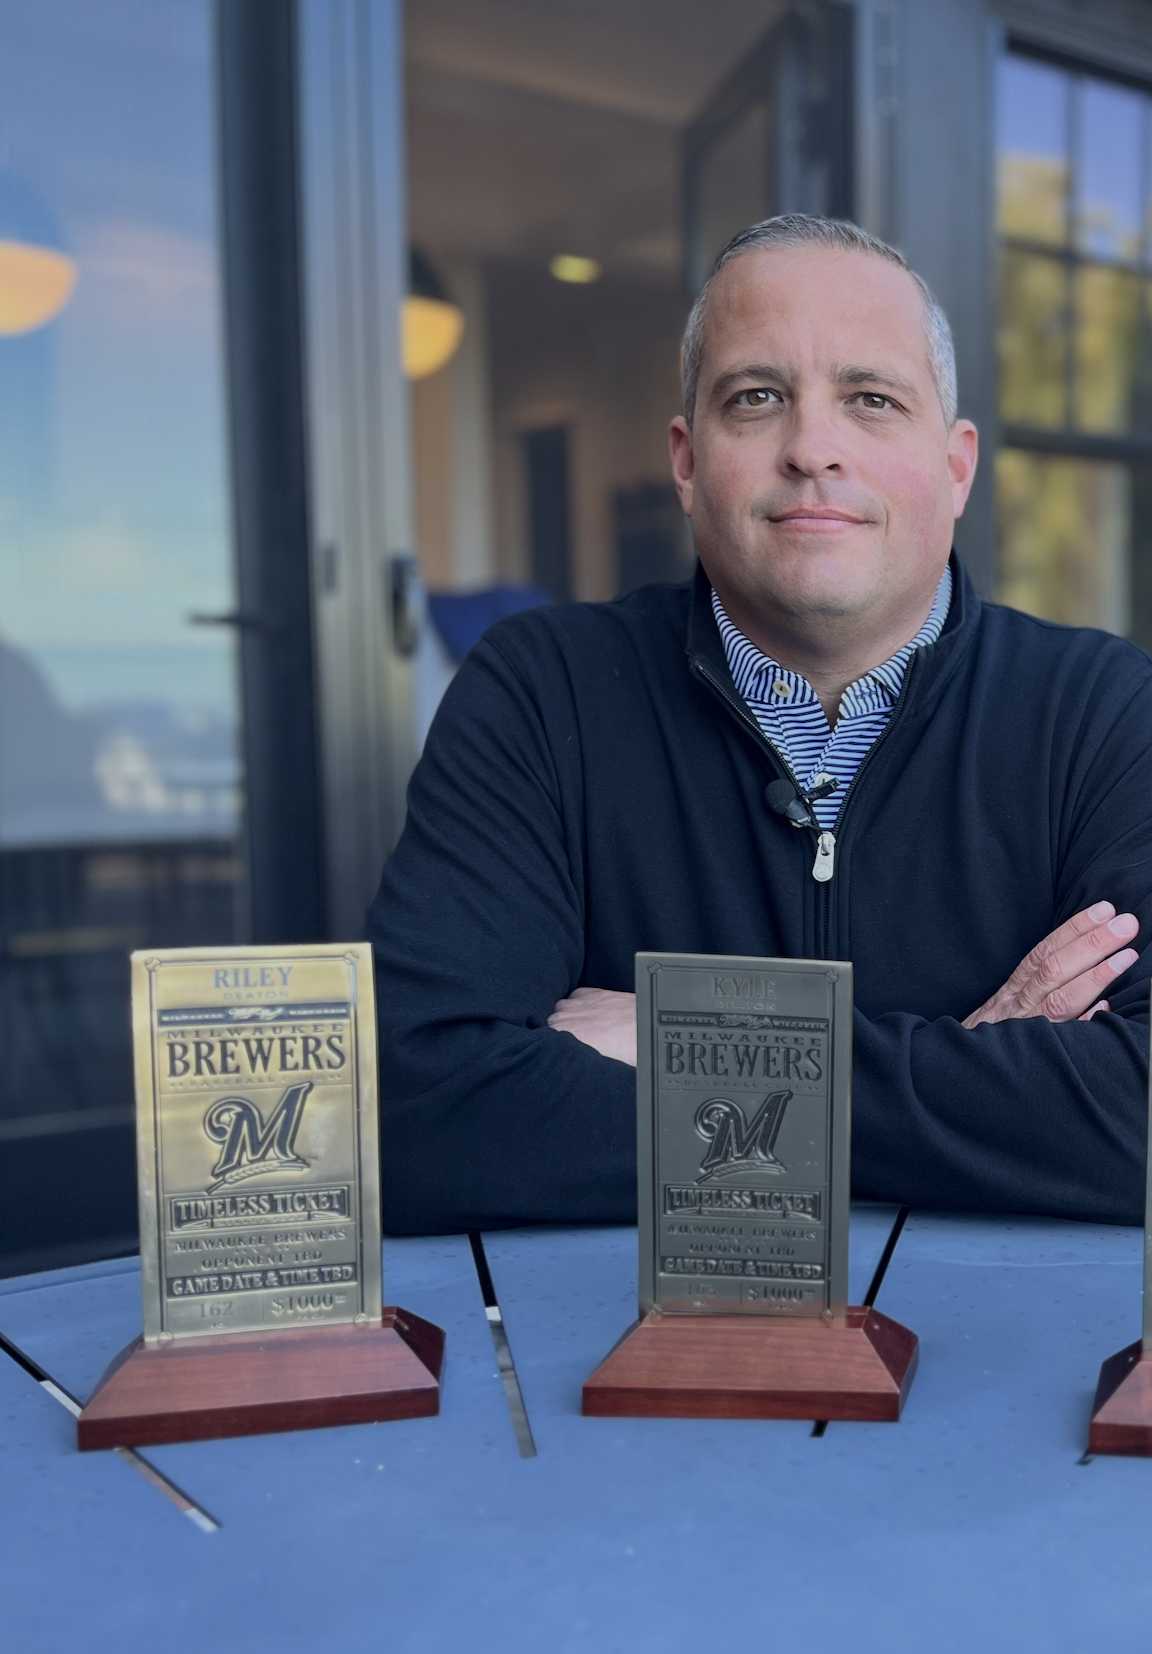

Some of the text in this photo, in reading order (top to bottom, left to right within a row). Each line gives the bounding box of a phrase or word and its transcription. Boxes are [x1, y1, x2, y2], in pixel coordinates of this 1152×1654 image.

[213, 966, 293, 988] RILEY
[711, 977, 777, 999] KYLE
[223, 991, 290, 1000] DEATON
[166, 1023, 343, 1039] MILWAUKEE
[664, 1031, 822, 1046] MILWAUKEE
[167, 1034, 346, 1077] BREWERS
[665, 1042, 823, 1082] BREWERS
[175, 1195, 271, 1221] TIMELESS
[273, 1190, 342, 1213] TICKET
[670, 1188, 815, 1212] TIMELESS TICKET
[175, 1235, 267, 1253] MILWAUKEE
[274, 1229, 347, 1246] BREWERS
[667, 1225, 817, 1240] MILWAUKEE BREWERS
[201, 1251, 323, 1271] OPPONENT TBD
[664, 1258, 822, 1278] GAME DATE & TIME TBD
[172, 1265, 353, 1296] GAME DATE & TIME TBD
[748, 1285, 803, 1302] $1000
[200, 1301, 234, 1318] 162
[271, 1294, 333, 1316] $1000
